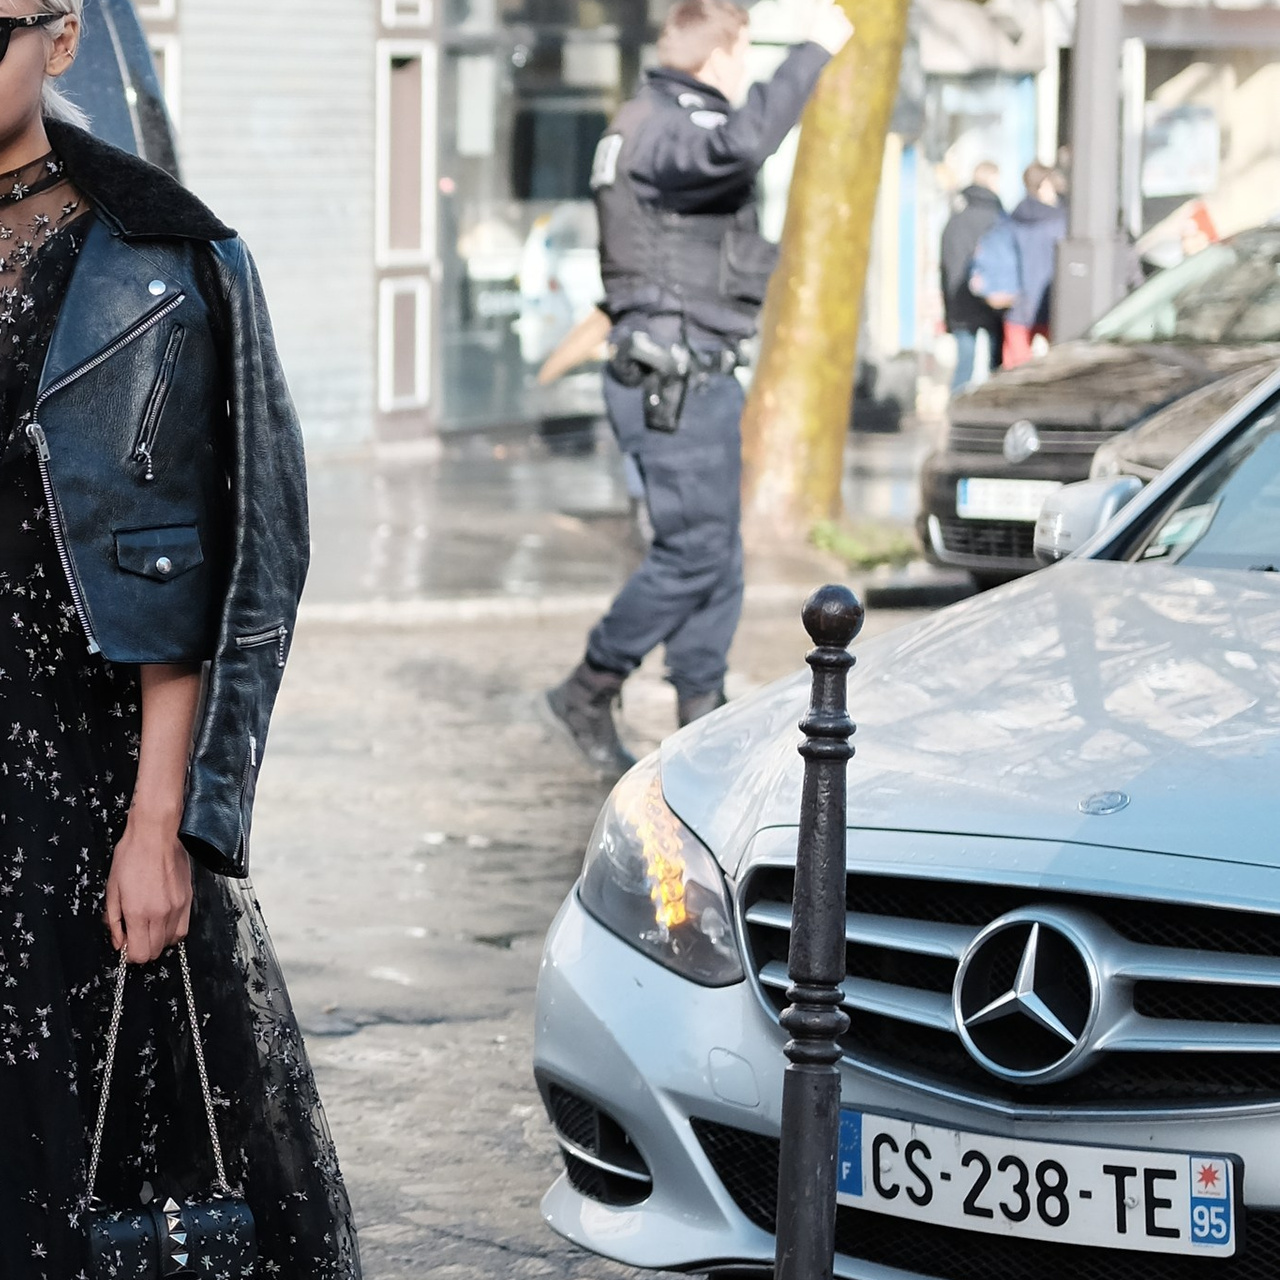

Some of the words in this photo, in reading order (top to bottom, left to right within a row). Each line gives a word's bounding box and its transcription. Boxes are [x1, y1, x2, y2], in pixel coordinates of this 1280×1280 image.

[842, 1161, 852, 1180] F
[872, 1132, 1181, 1239] CS-238-TE
[1192, 1205, 1227, 1239] 95
